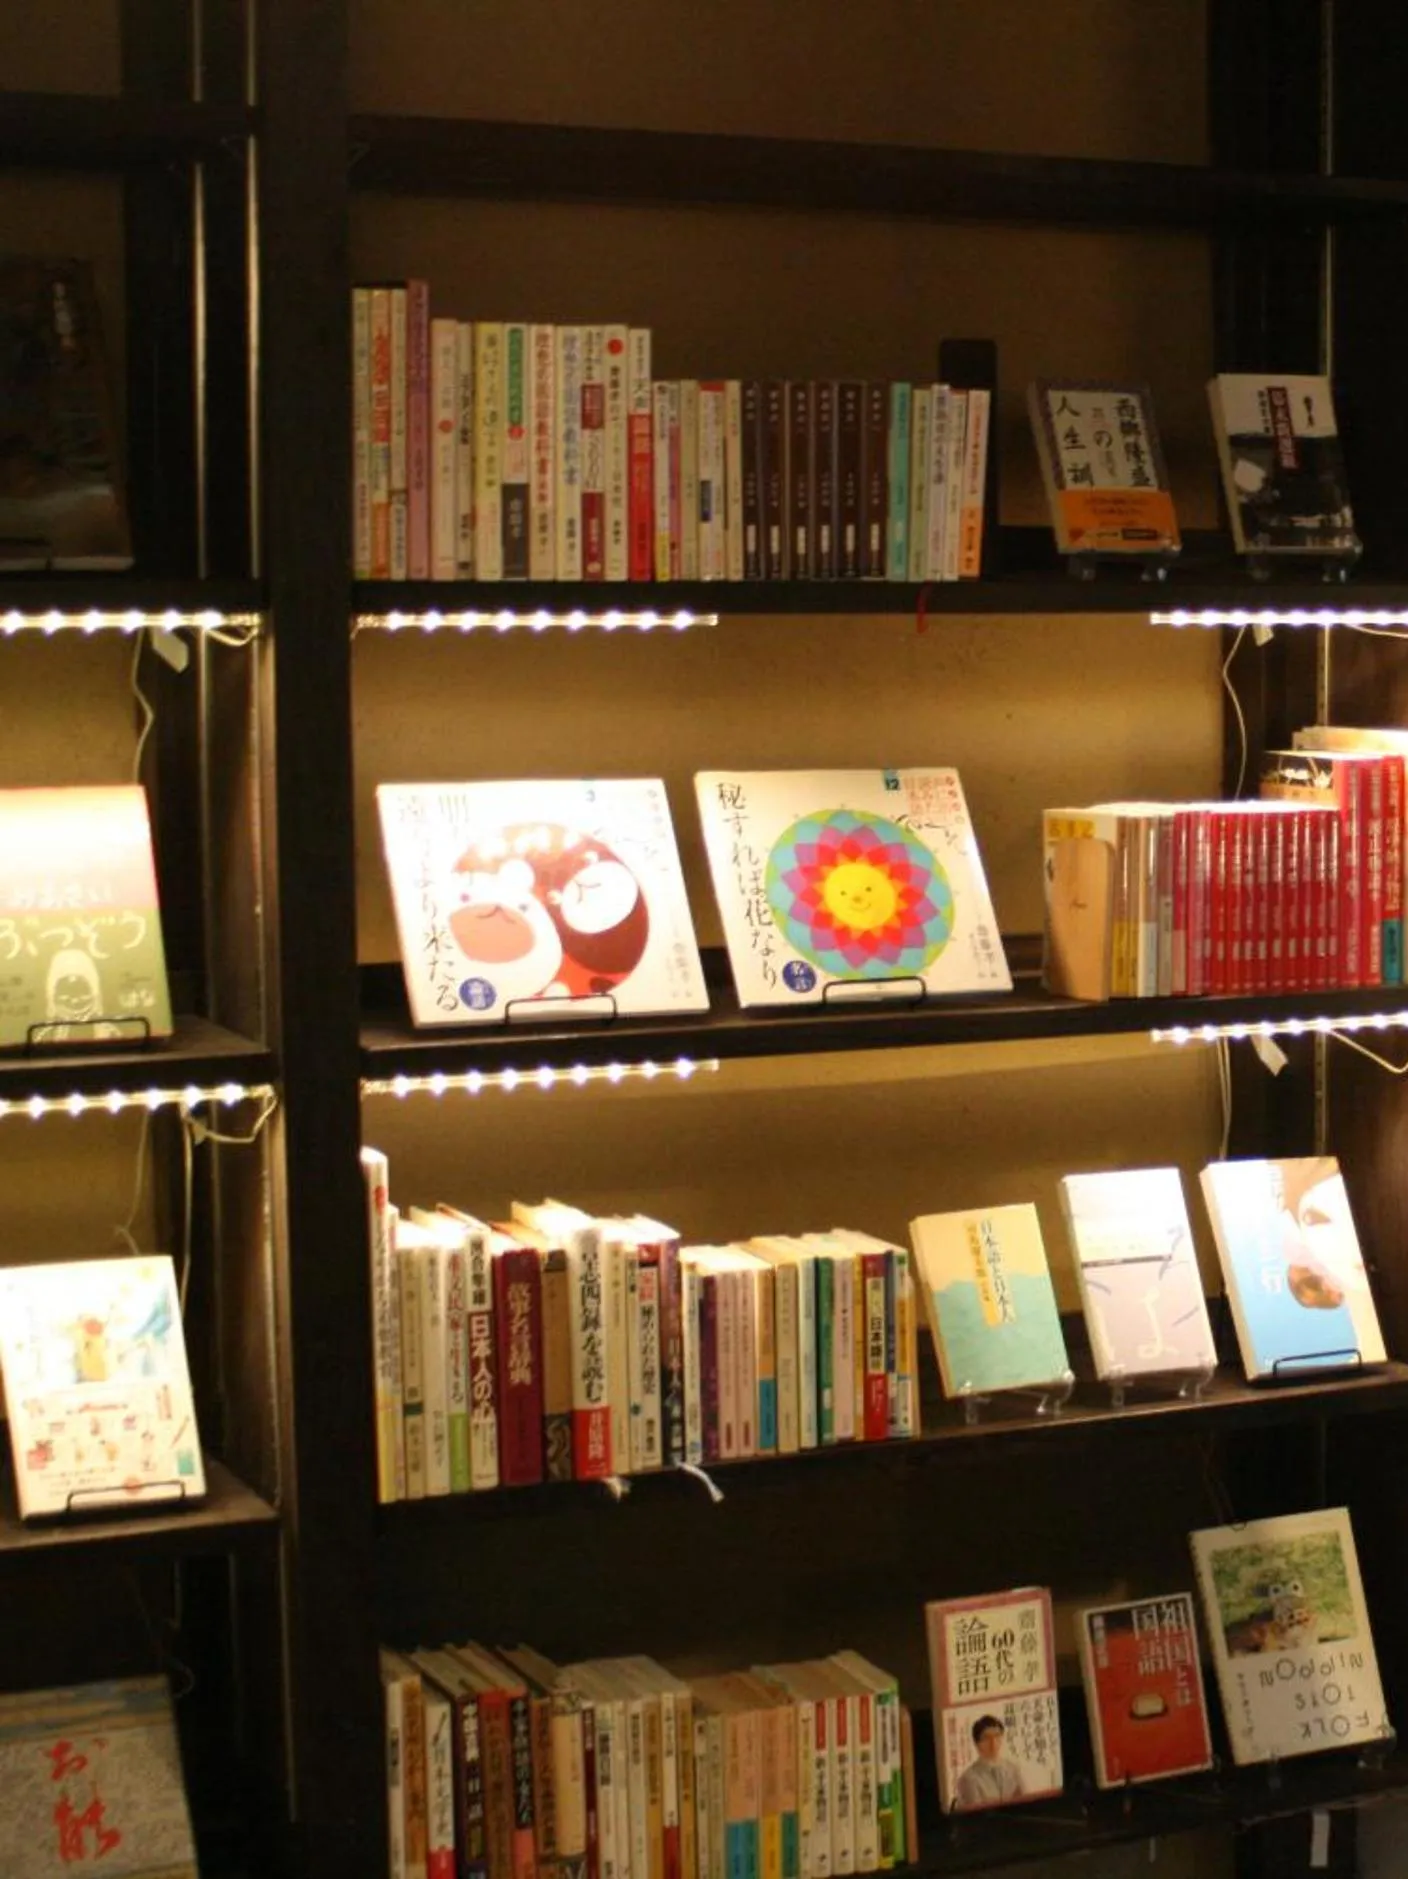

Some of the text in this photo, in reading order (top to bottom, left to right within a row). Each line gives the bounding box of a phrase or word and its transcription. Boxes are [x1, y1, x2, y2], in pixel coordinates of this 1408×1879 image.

[717, 782, 778, 990] 秘すれば花なり
[953, 1615, 992, 1696] 論語
[991, 1628, 1017, 1686] 60代の
[1260, 1652, 1363, 1686] NIPPON
[1295, 1683, 1355, 1711] TOYS
[1301, 1711, 1370, 1738] FOLK
